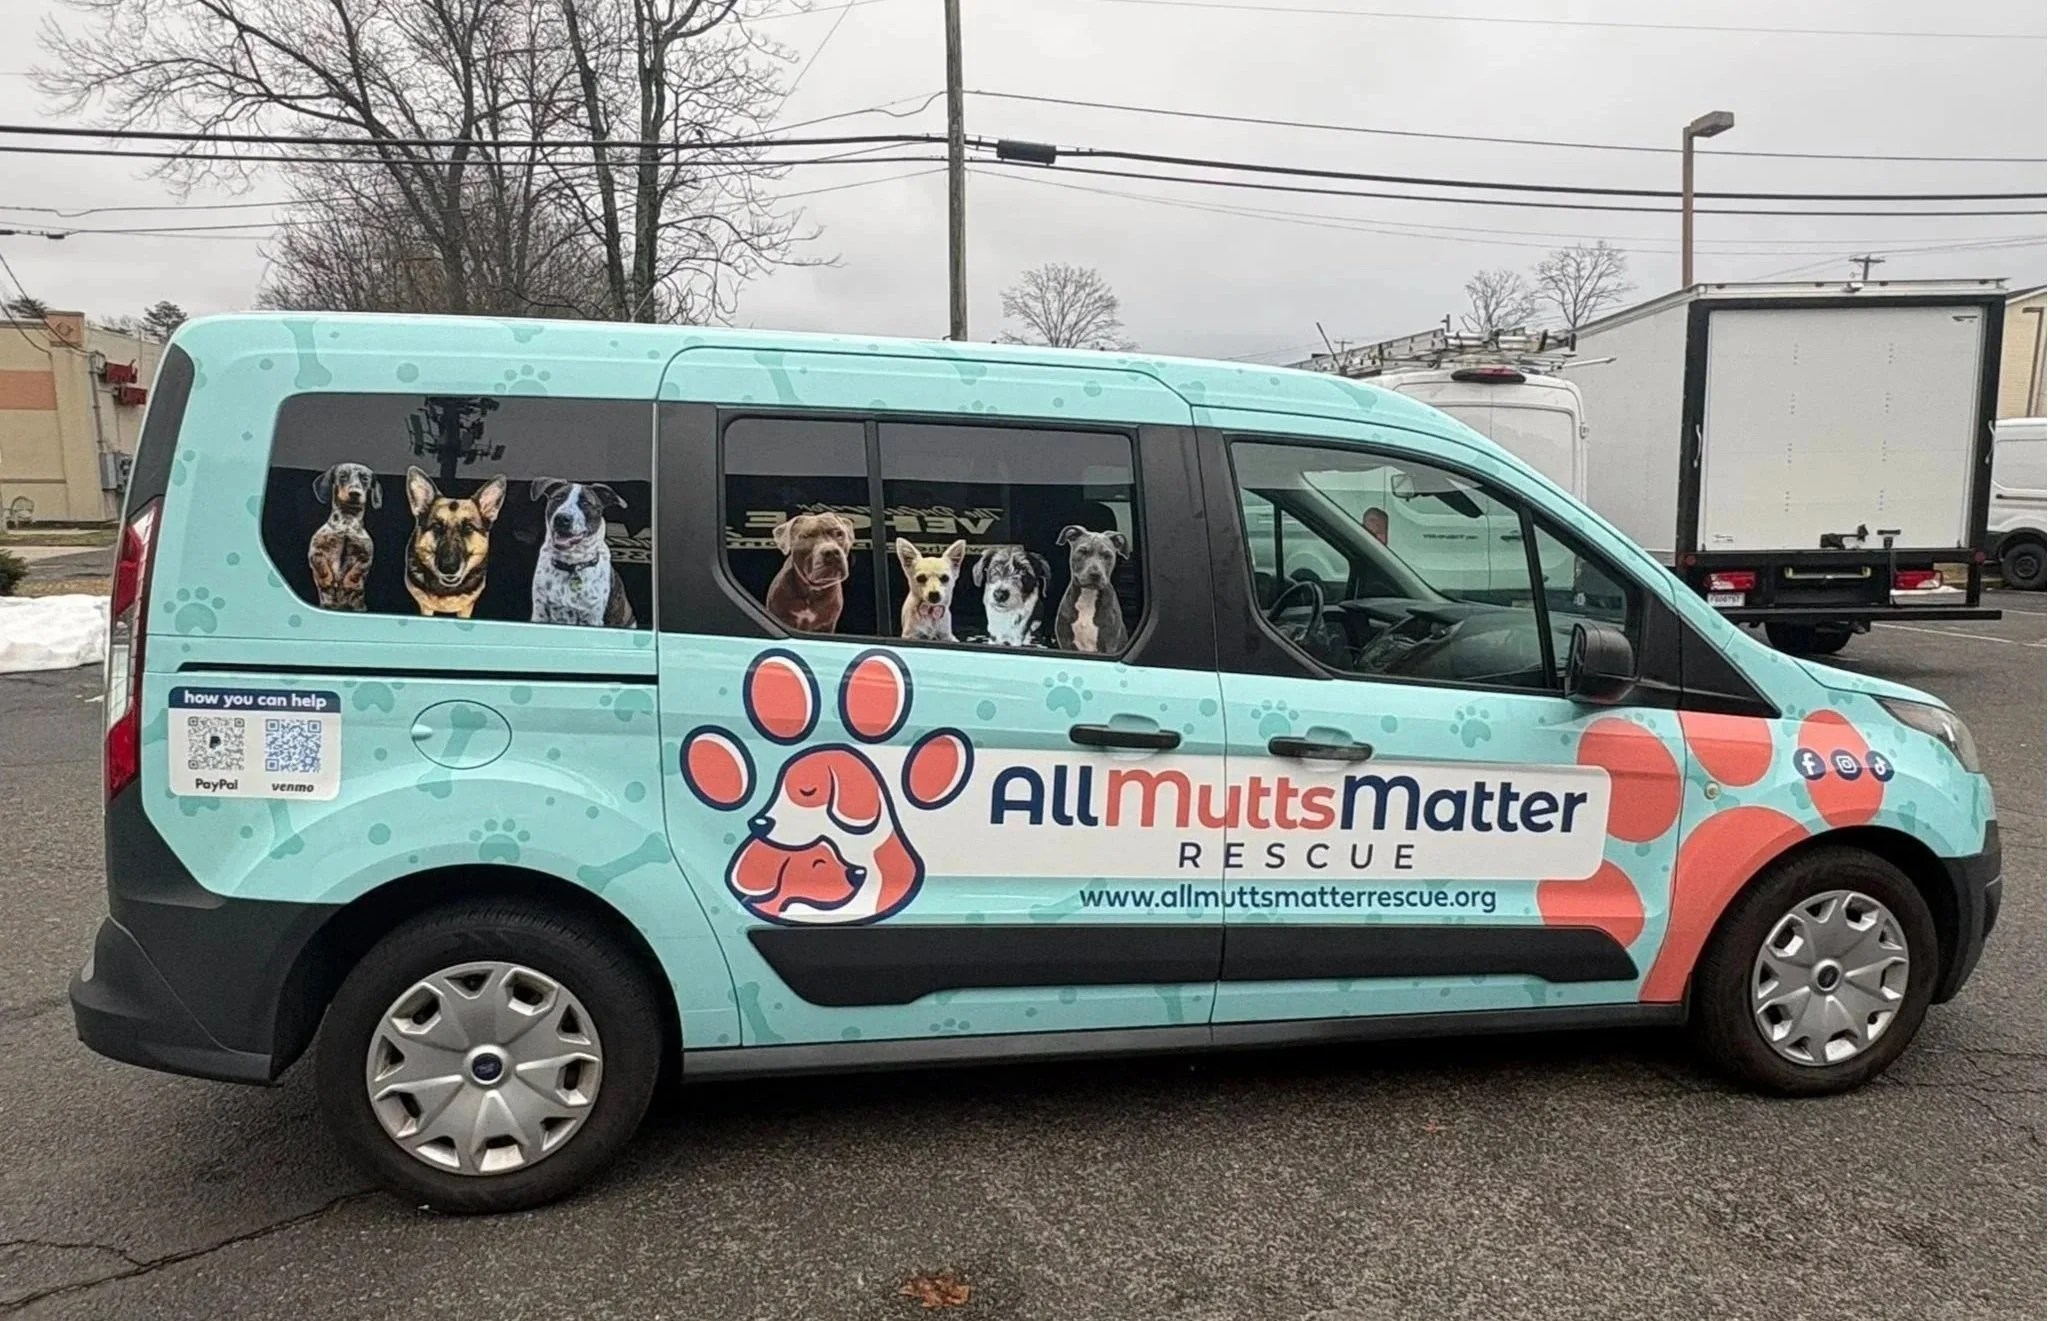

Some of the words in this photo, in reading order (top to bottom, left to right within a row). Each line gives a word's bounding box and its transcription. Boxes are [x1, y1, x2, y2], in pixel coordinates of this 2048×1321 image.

[184, 690, 219, 705] how
[222, 694, 253, 708] you
[258, 695, 287, 707] can
[291, 694, 327, 710] help
[195, 778, 239, 792] PayPal
[271, 783, 315, 793] venmo
[990, 765, 1588, 833] AllMuttsMatter
[1178, 842, 1415, 870] RESCUE
[1080, 884, 1496, 914] www.allmuttsmatterrescue.org
